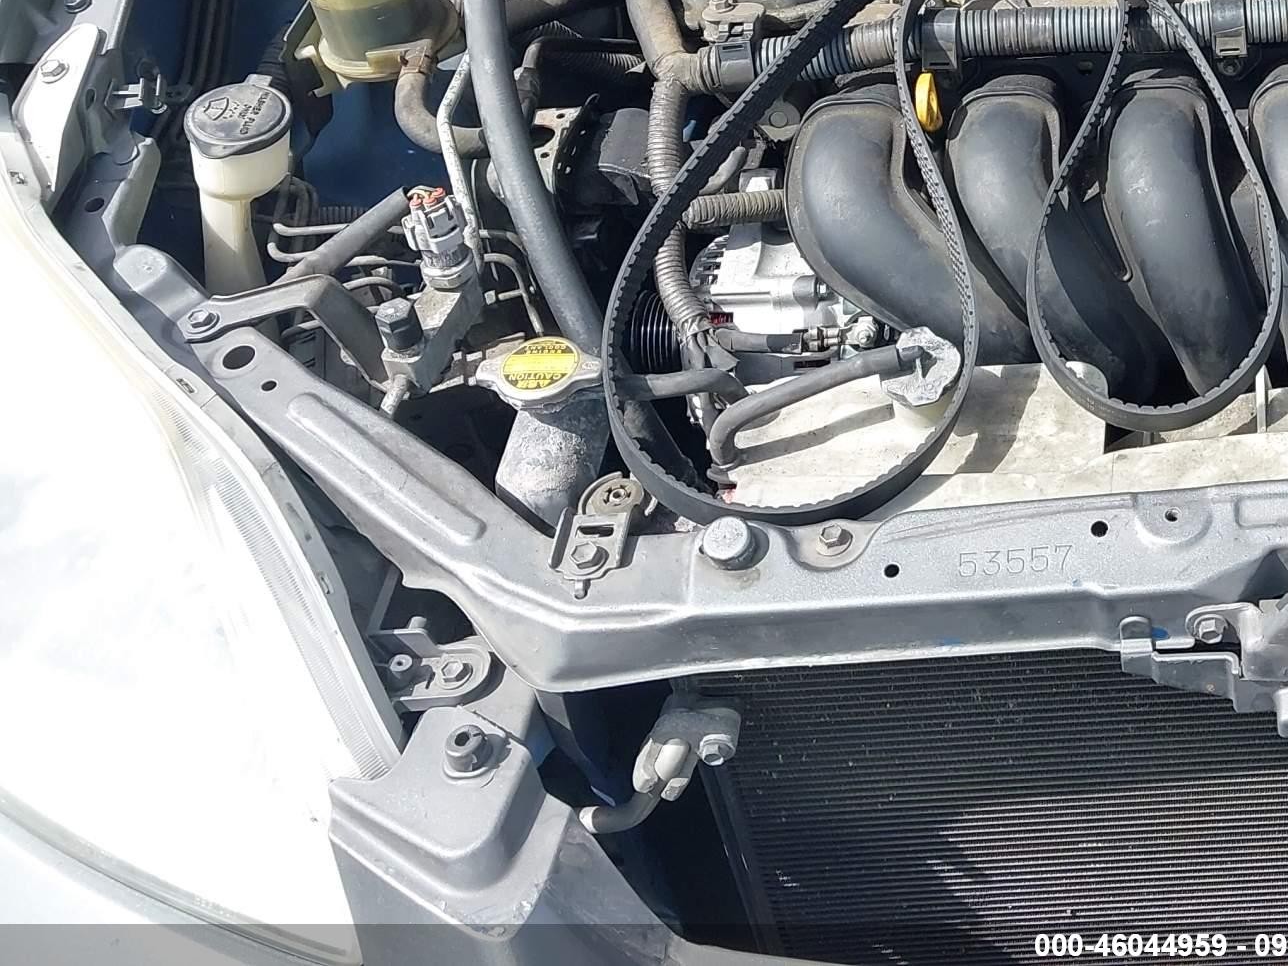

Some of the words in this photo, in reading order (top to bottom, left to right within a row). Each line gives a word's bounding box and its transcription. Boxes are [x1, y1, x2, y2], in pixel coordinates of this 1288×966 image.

[239, 117, 256, 135] FLUID
[508, 373, 562, 381] CAUTION
[959, 543, 1073, 577] 53557
